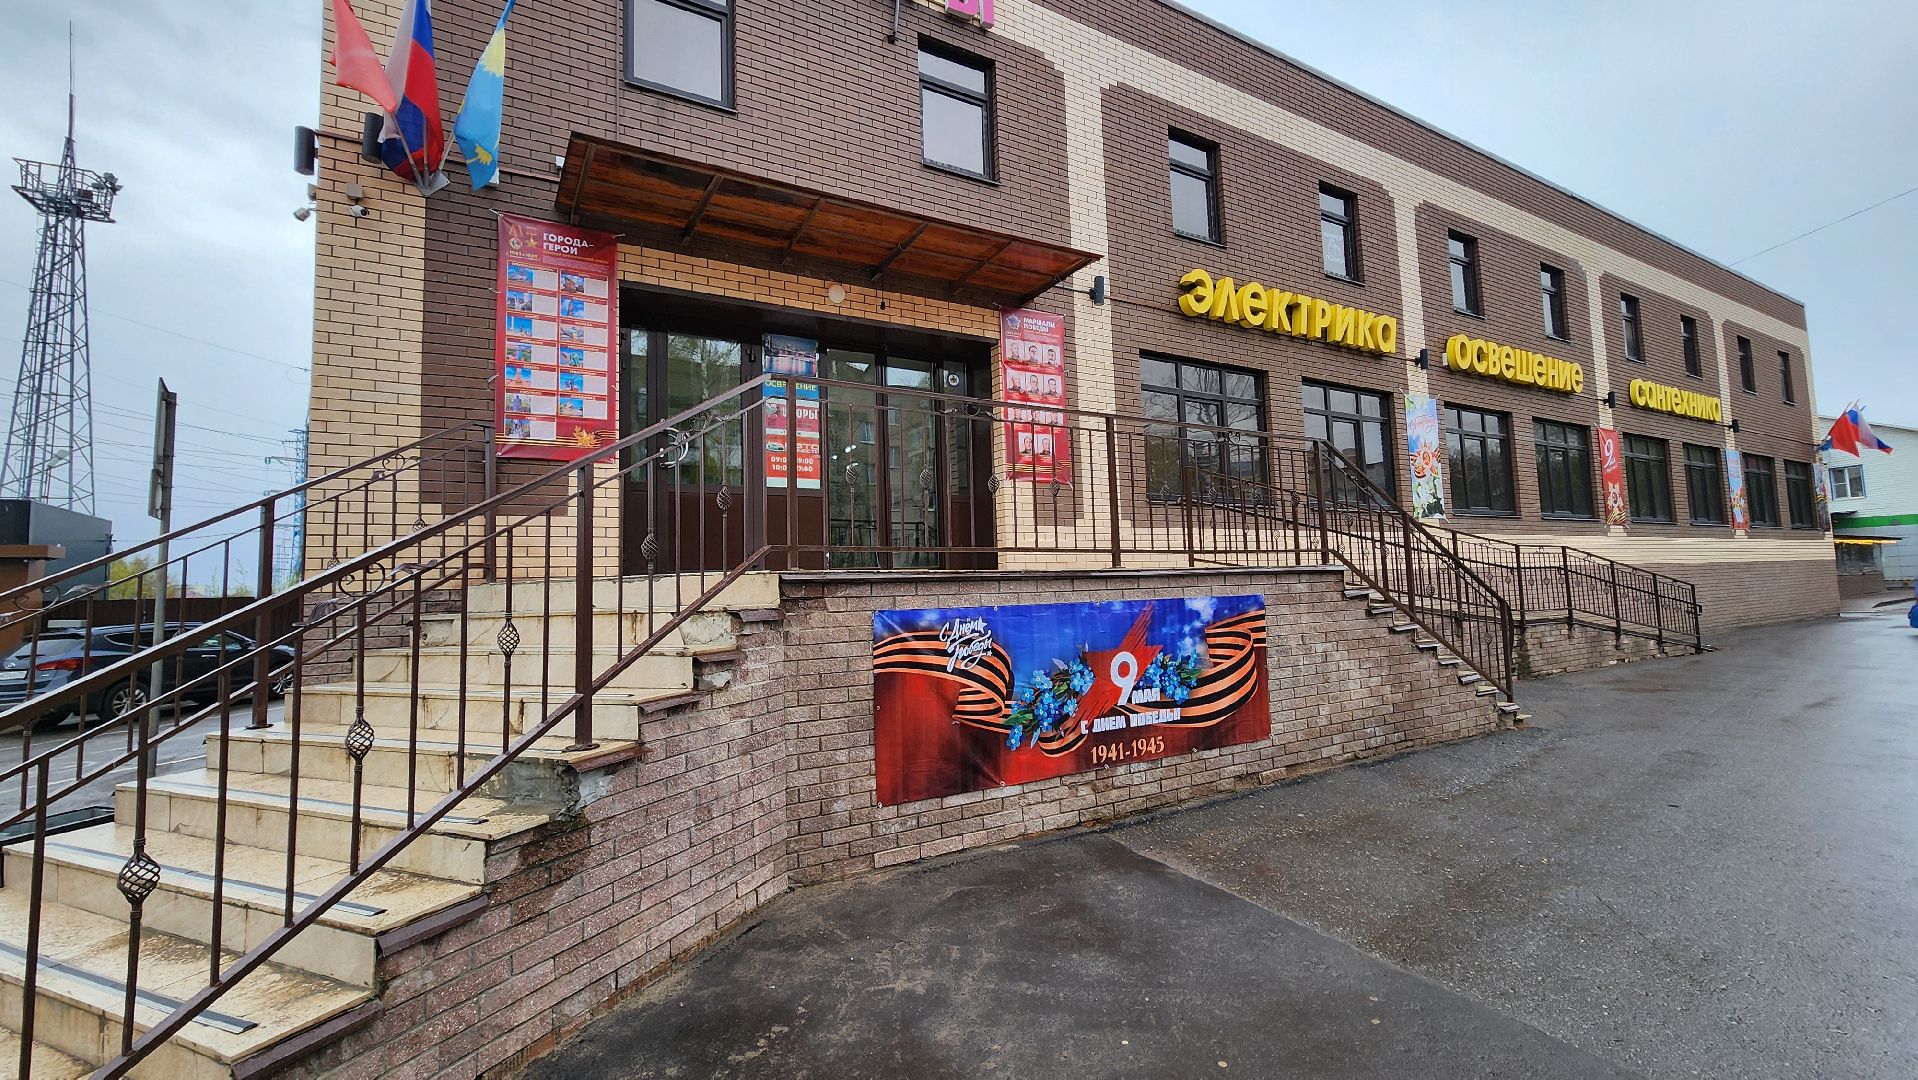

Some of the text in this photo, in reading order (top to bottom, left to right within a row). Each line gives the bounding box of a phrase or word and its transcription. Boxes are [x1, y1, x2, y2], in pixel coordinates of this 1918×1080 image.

[542, 242, 578, 255] ГЕРОИ
[1110, 651, 1138, 706] 9
[1131, 687, 1161, 705] МАЯ
[1080, 708, 1181, 735] С ДНЕМ ПОБЕДЫ
[1091, 736, 1165, 765] 1941-1945
